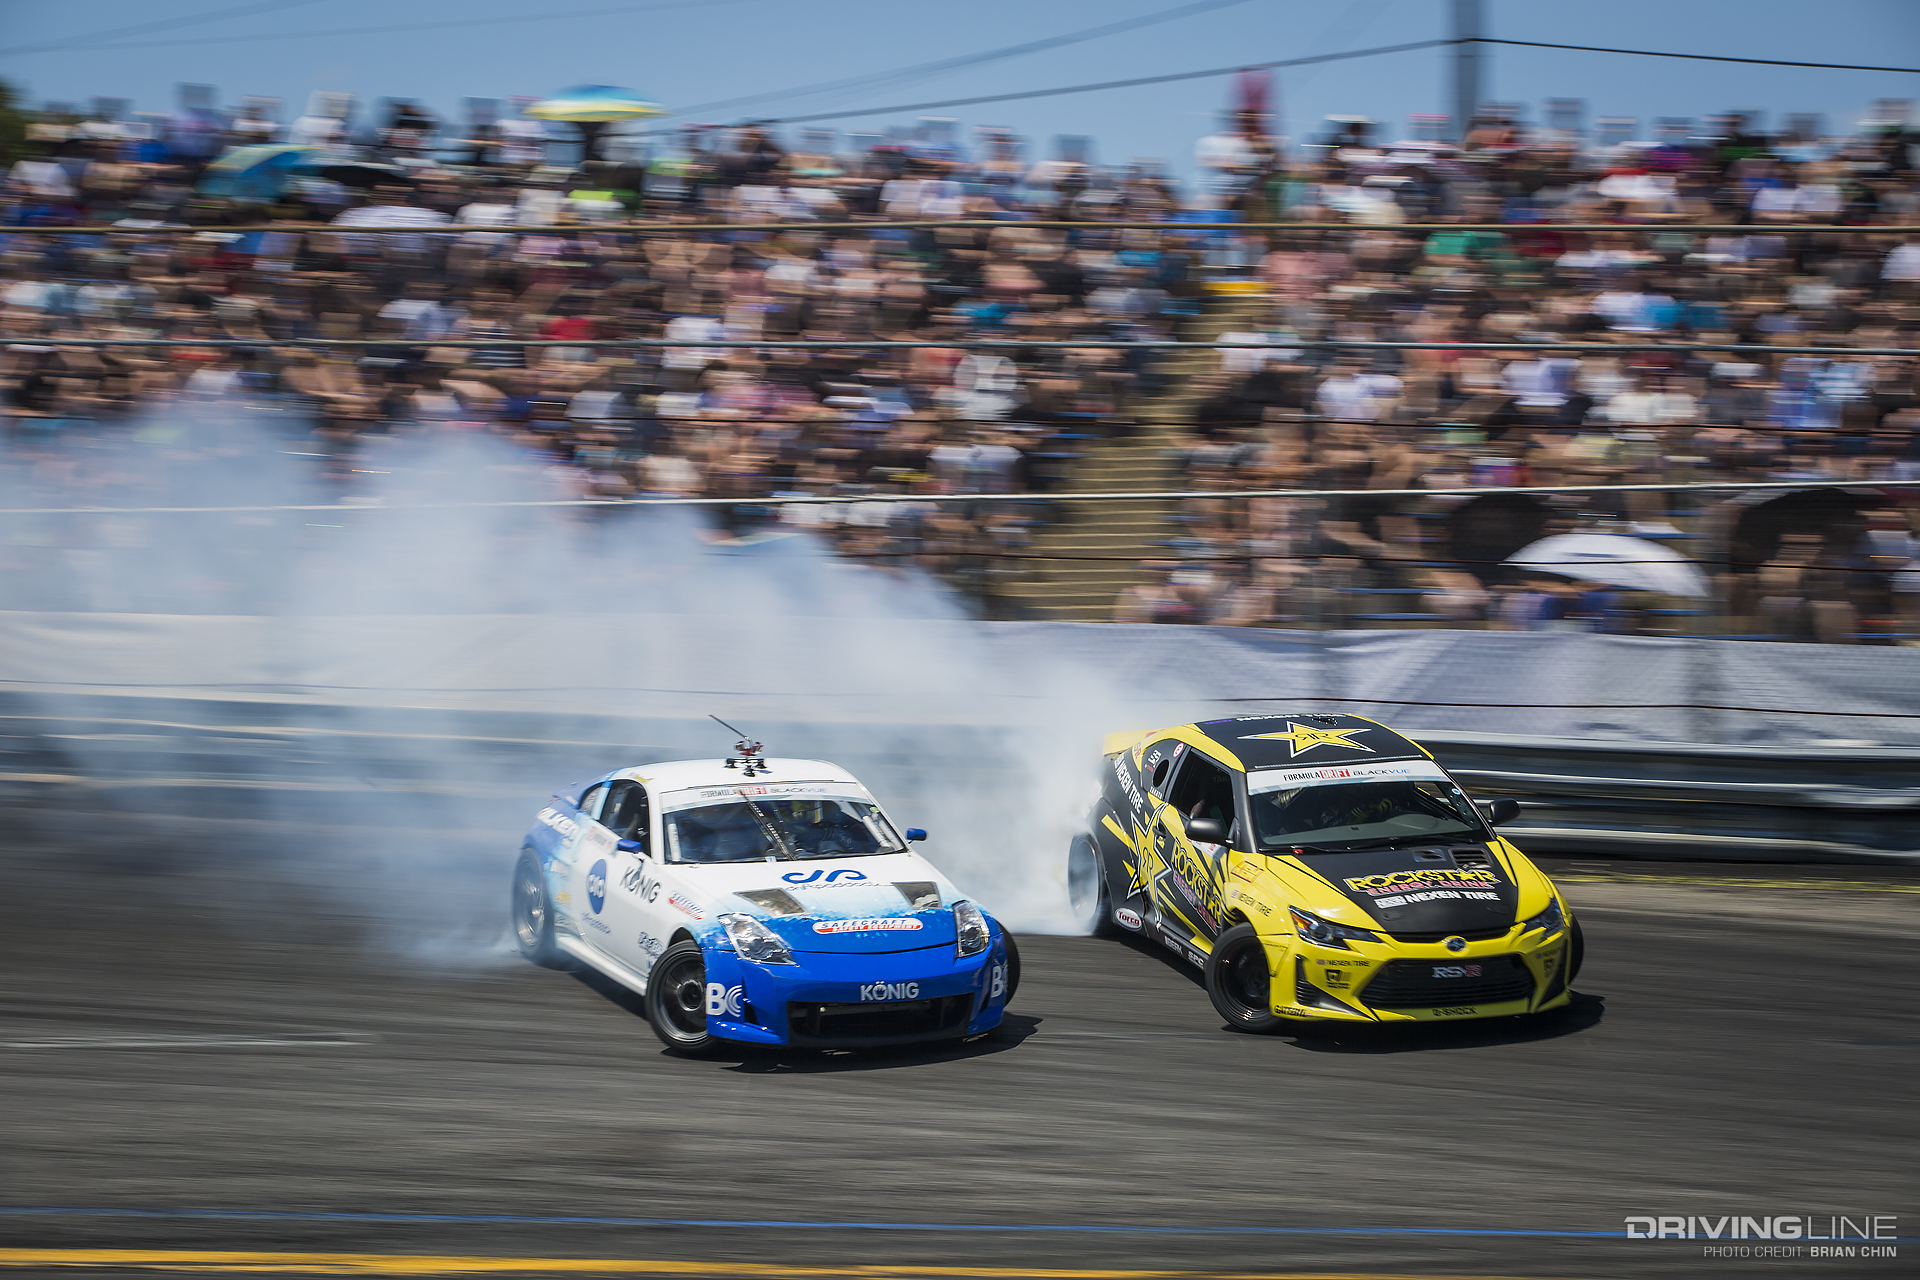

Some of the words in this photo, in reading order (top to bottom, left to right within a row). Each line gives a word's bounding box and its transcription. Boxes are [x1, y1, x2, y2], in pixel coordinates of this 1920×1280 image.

[1283, 771, 1320, 781] FORMULA
[1319, 769, 1351, 779] DRIFT
[1352, 768, 1411, 776] BLACKVUE
[1116, 760, 1134, 794] NEXEN
[1128, 784, 1143, 814] TIRE
[1346, 869, 1500, 891] ROCKSTAR
[1368, 880, 1433, 896] ENERGY
[1438, 879, 1492, 888] DRINK
[1404, 890, 1461, 904] NEXEN
[1460, 890, 1501, 901] TIRE
[821, 919, 907, 929] SAFECRAFT
[1118, 911, 1140, 926] Torco
[860, 980, 920, 1001] KÖNIG
